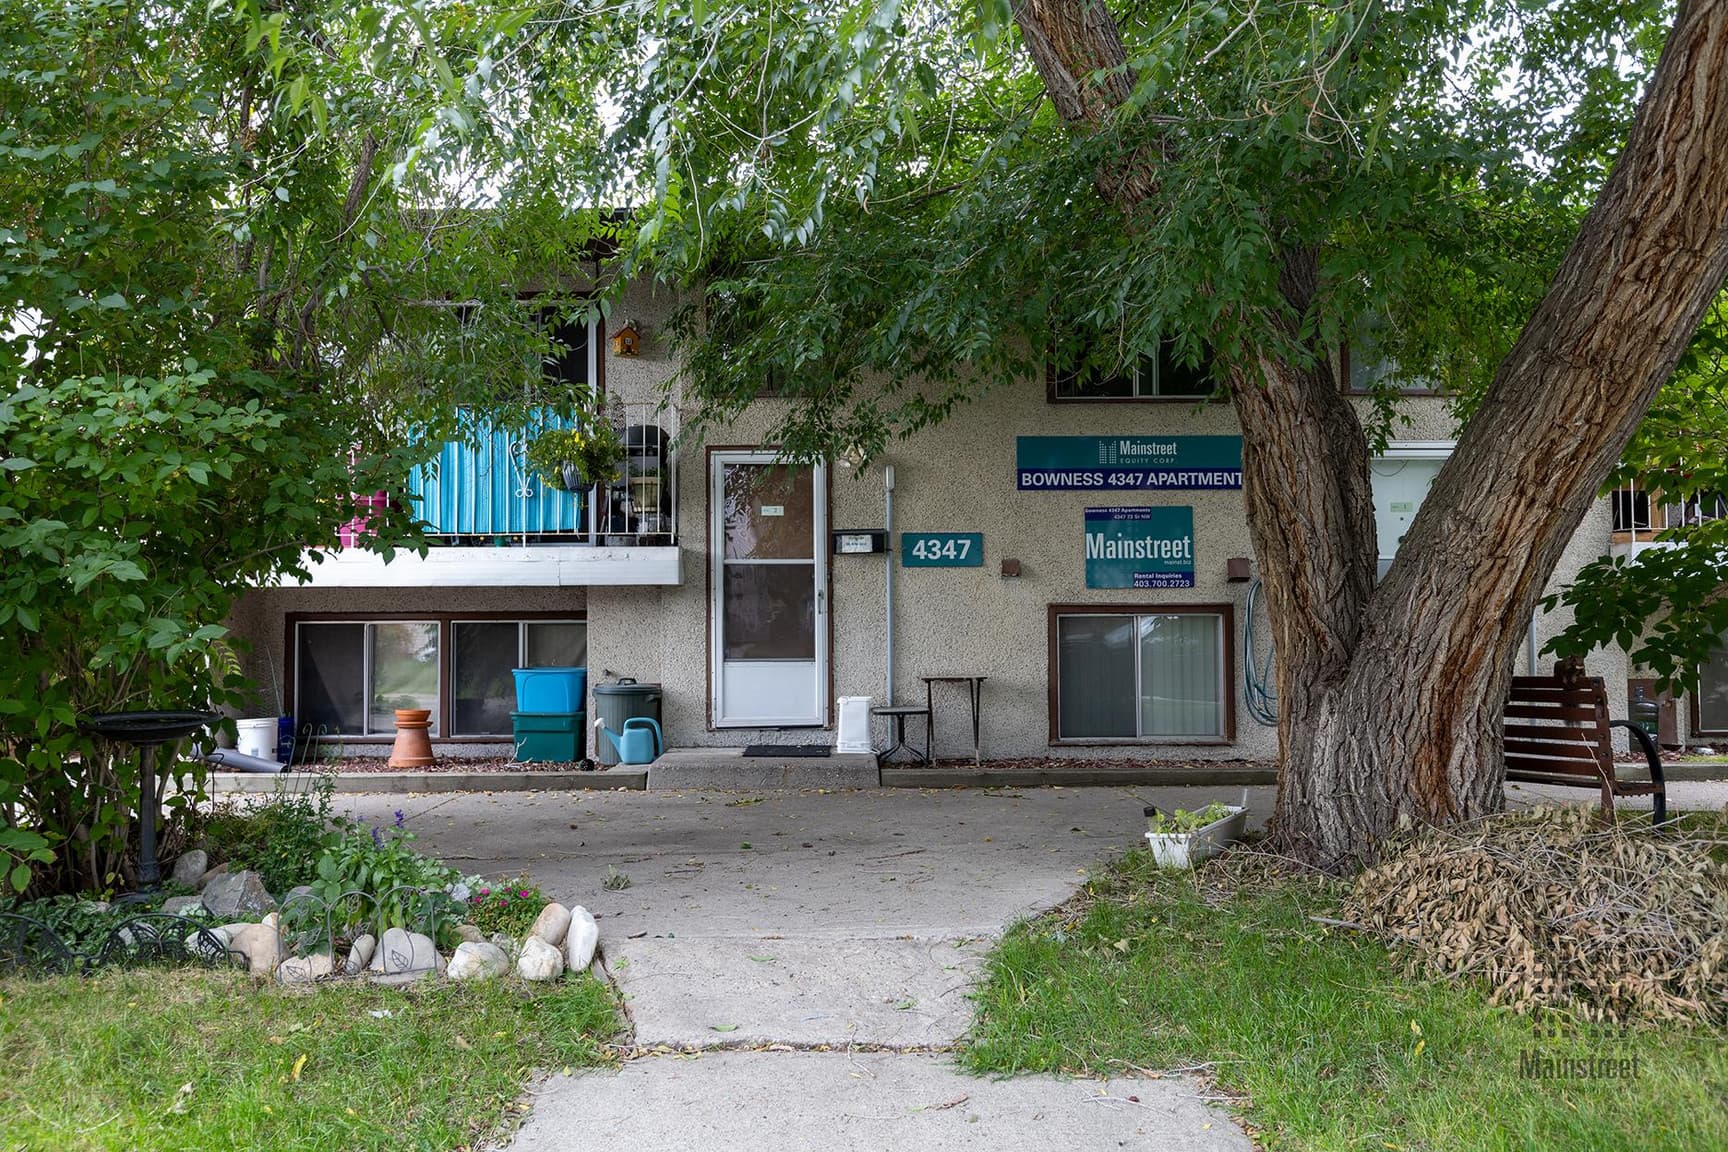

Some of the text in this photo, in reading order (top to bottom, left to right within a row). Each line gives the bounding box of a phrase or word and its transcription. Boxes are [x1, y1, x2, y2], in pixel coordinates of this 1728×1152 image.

[1120, 441, 1177, 455] Mainstreet
[1022, 472, 1104, 486] BOWNESS
[1107, 472, 1144, 486] 4347
[912, 539, 972, 560] 4347
[1086, 533, 1191, 559] Mainstreet
[1133, 580, 1190, 588] 403.700.2723
